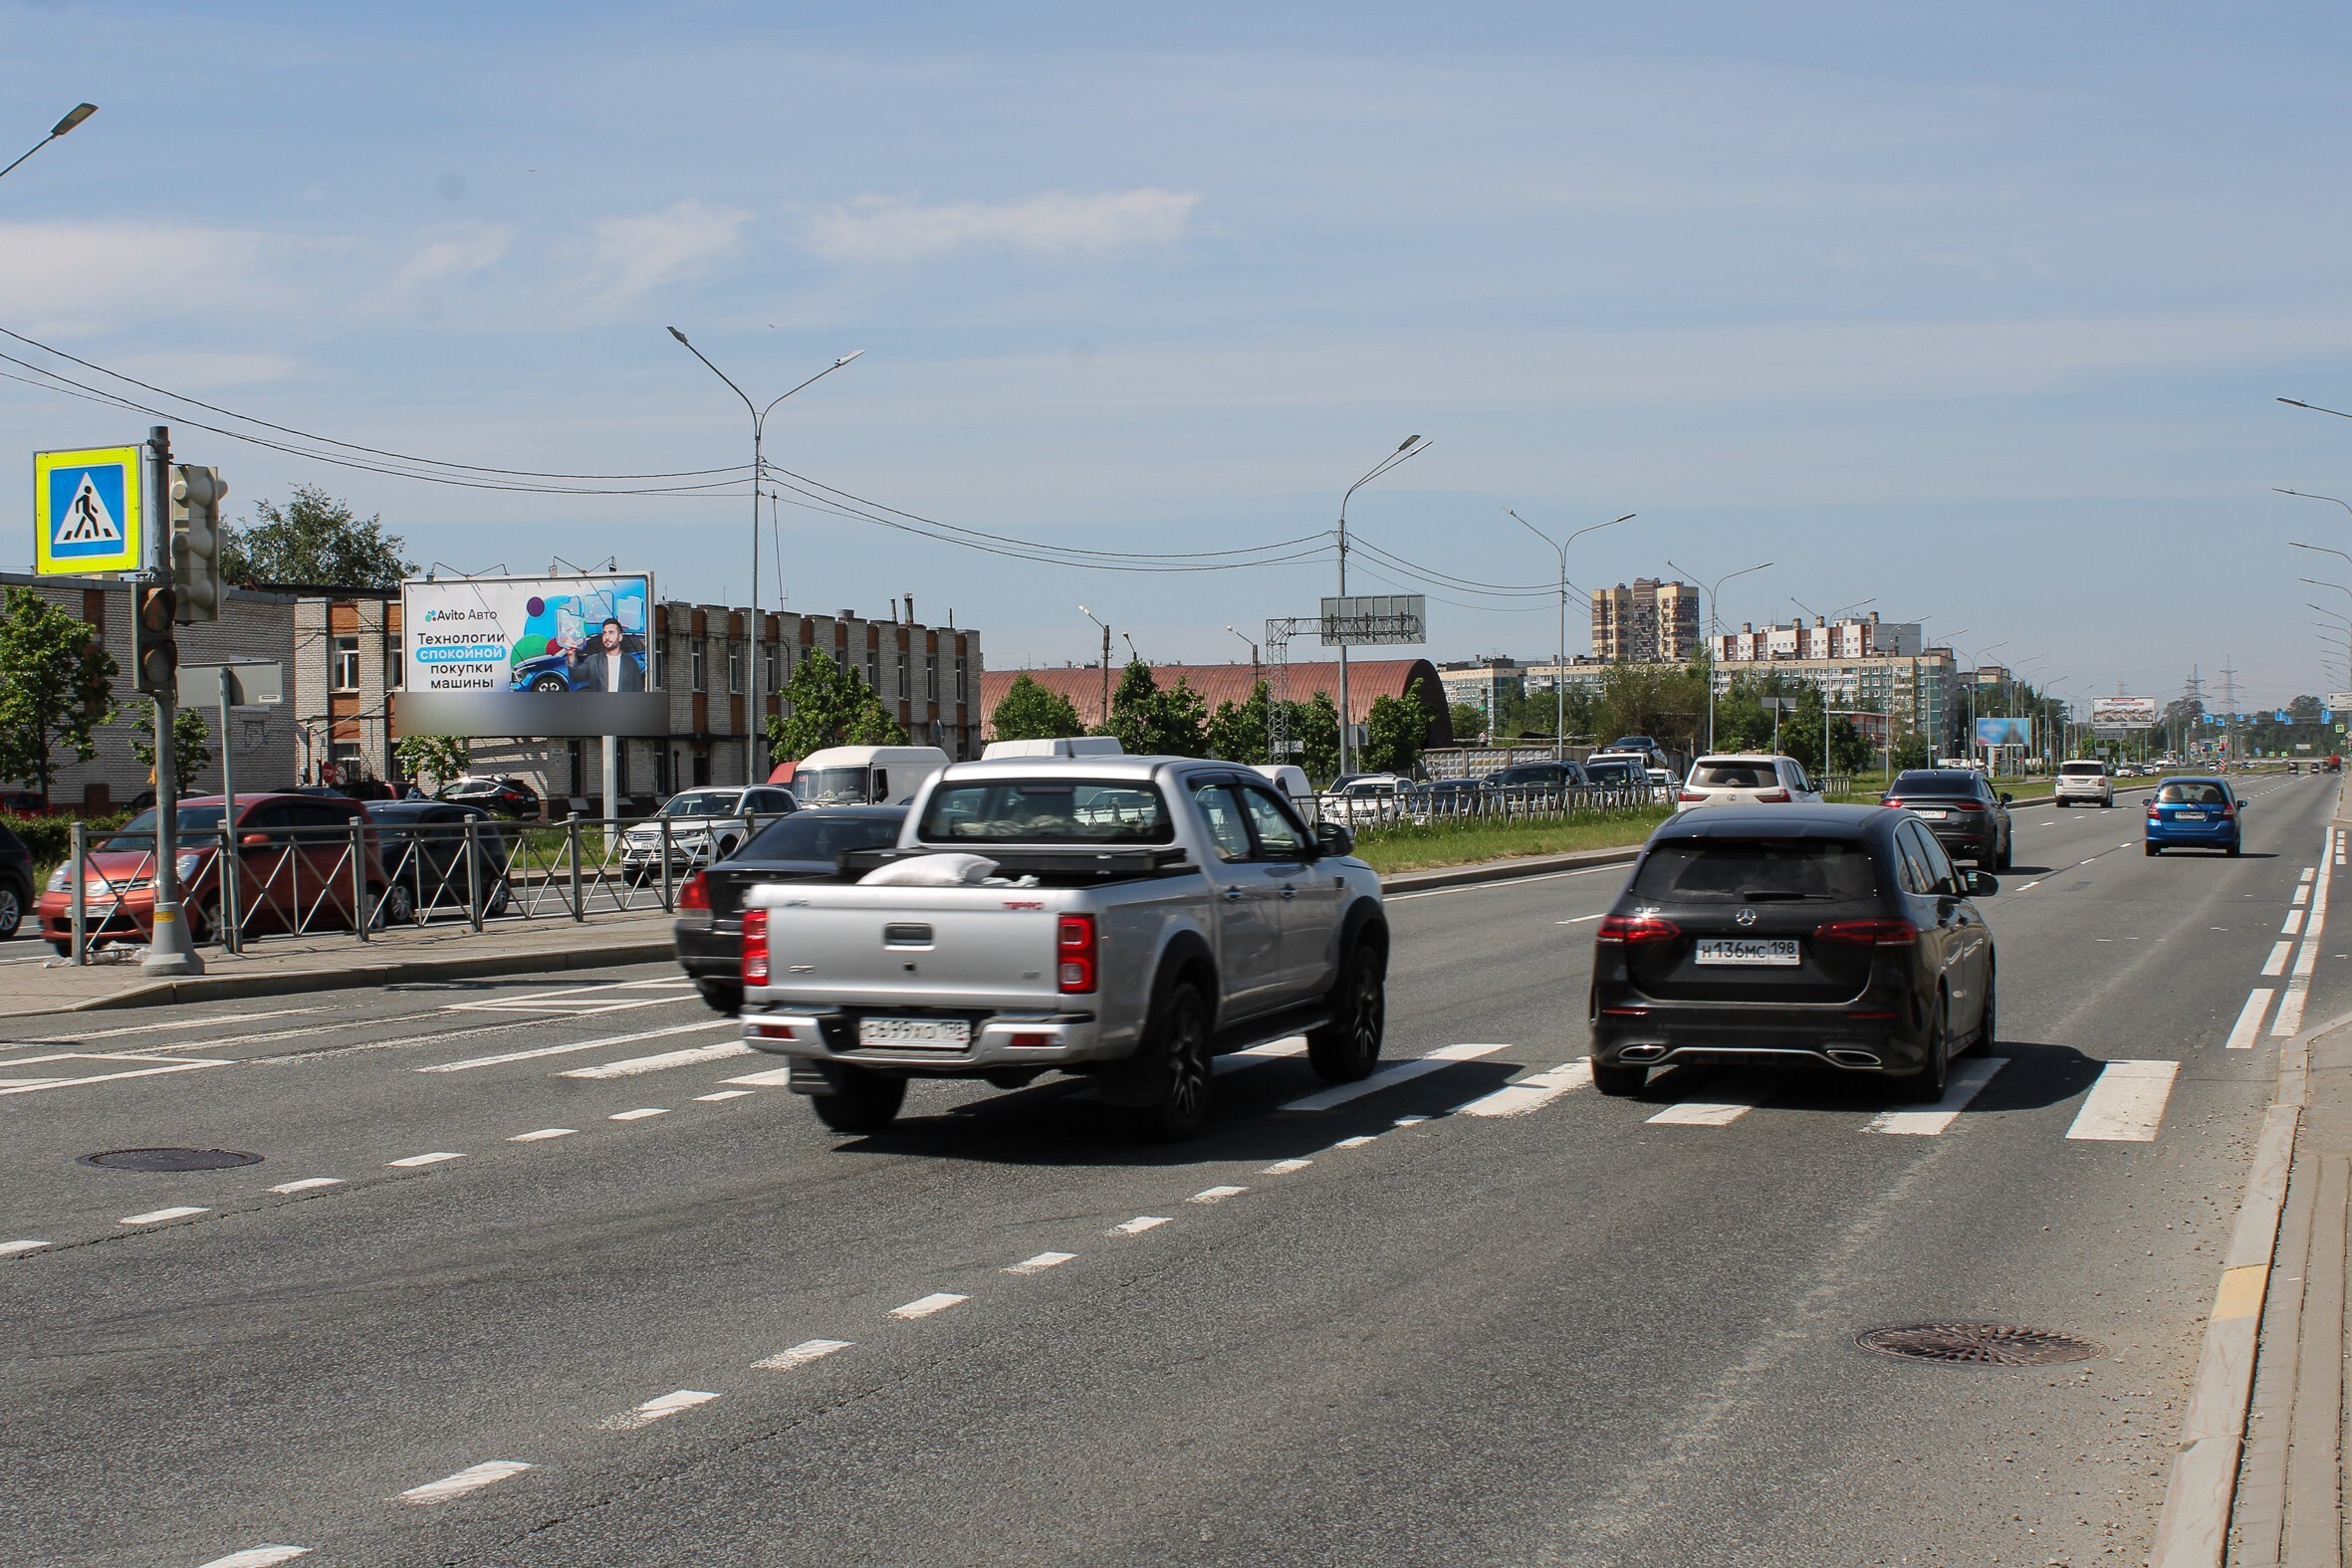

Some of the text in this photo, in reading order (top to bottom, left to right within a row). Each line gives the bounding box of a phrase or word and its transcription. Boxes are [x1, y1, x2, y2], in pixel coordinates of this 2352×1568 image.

[437, 608, 498, 621] Avito Авто
[417, 632, 505, 645] Технологии
[419, 646, 503, 660] спокойной
[430, 663, 493, 677] покупки
[430, 678, 494, 689] машины
[1770, 941, 1796, 954] 198
